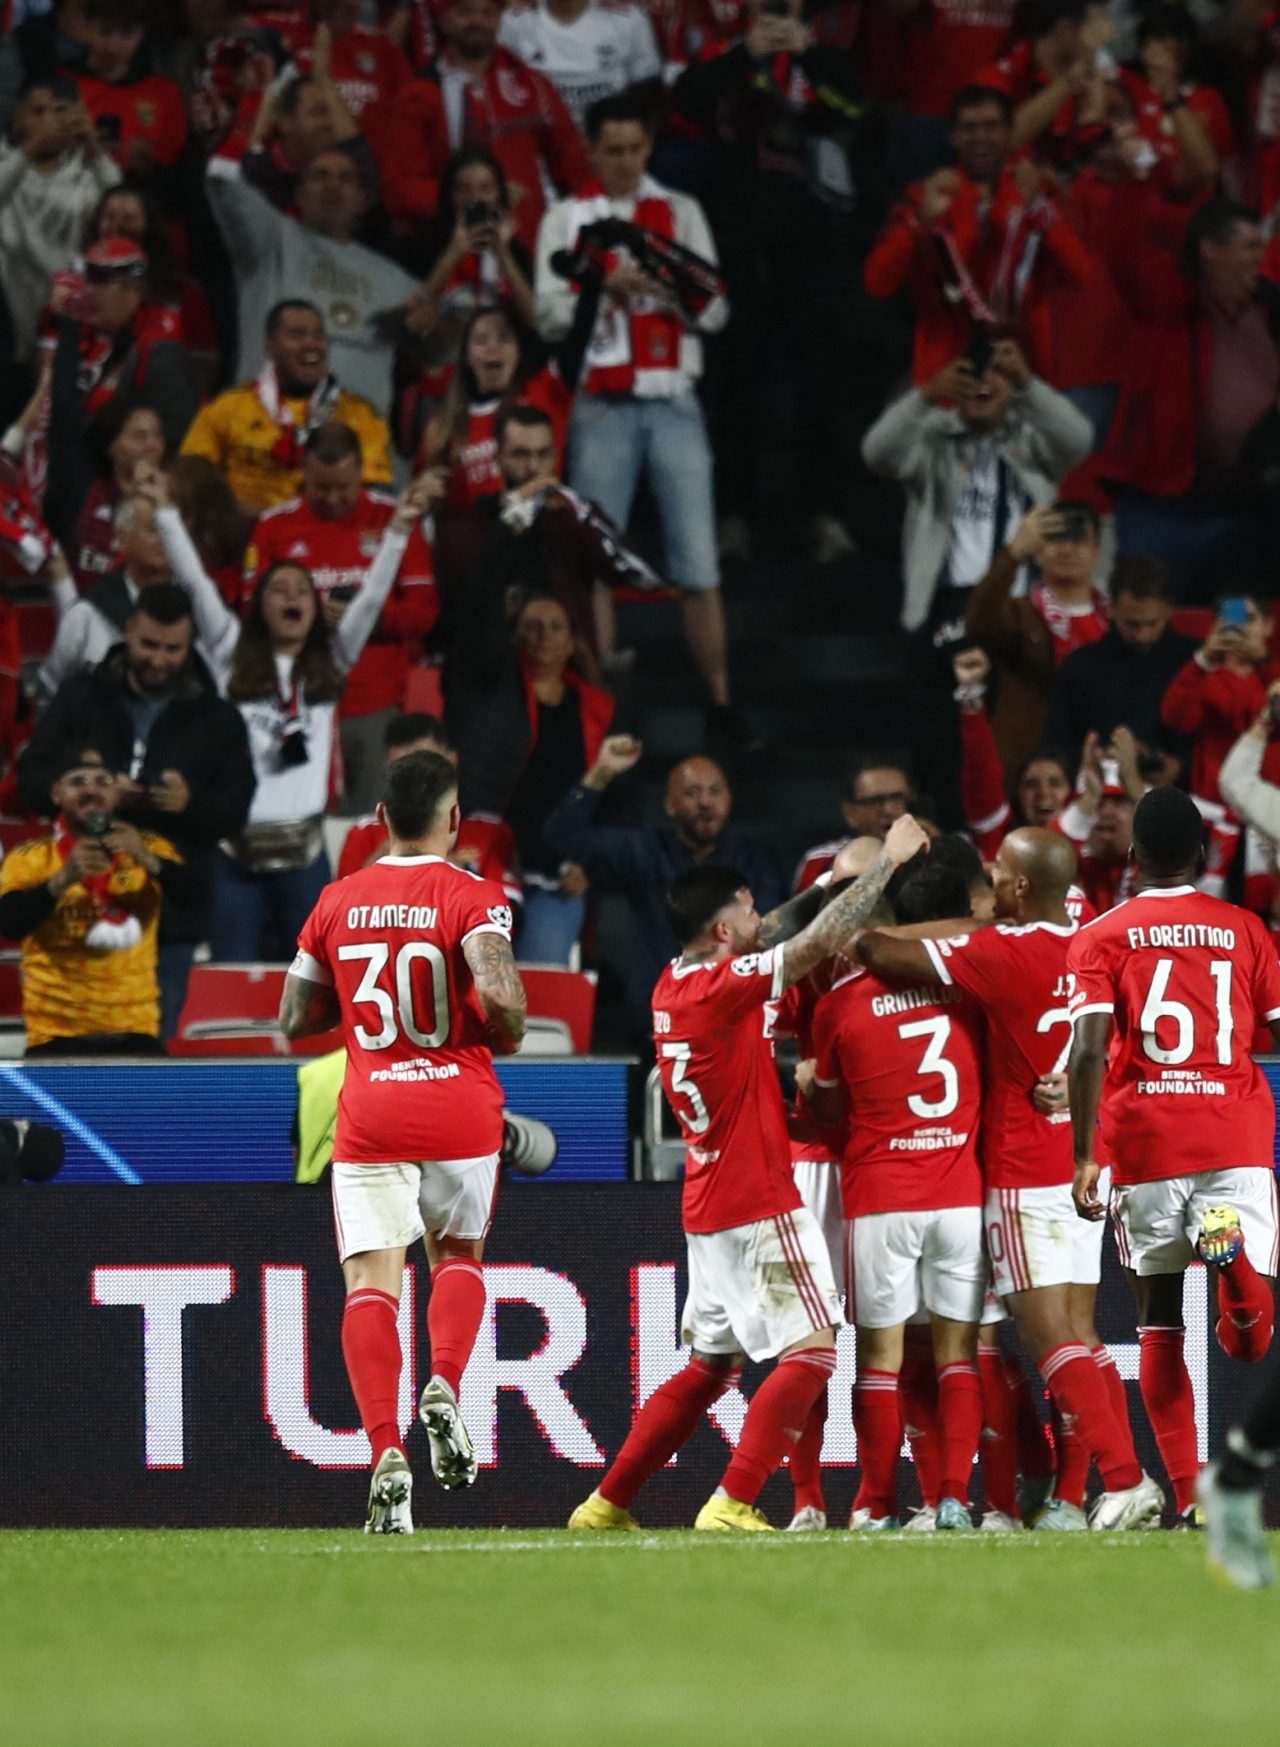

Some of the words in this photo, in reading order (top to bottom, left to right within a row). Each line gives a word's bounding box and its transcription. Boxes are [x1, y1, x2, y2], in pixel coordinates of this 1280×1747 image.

[347, 905, 438, 929] OTAMENDI
[1128, 924, 1235, 950] FLORENTINO
[338, 941, 449, 1050] 30
[1140, 959, 1234, 1065] 61
[370, 1063, 460, 1082] FOUNDATION
[898, 1014, 959, 1118] 3
[1161, 1070, 1202, 1081] BENFICA
[1137, 1081, 1225, 1095] FOUNDATION
